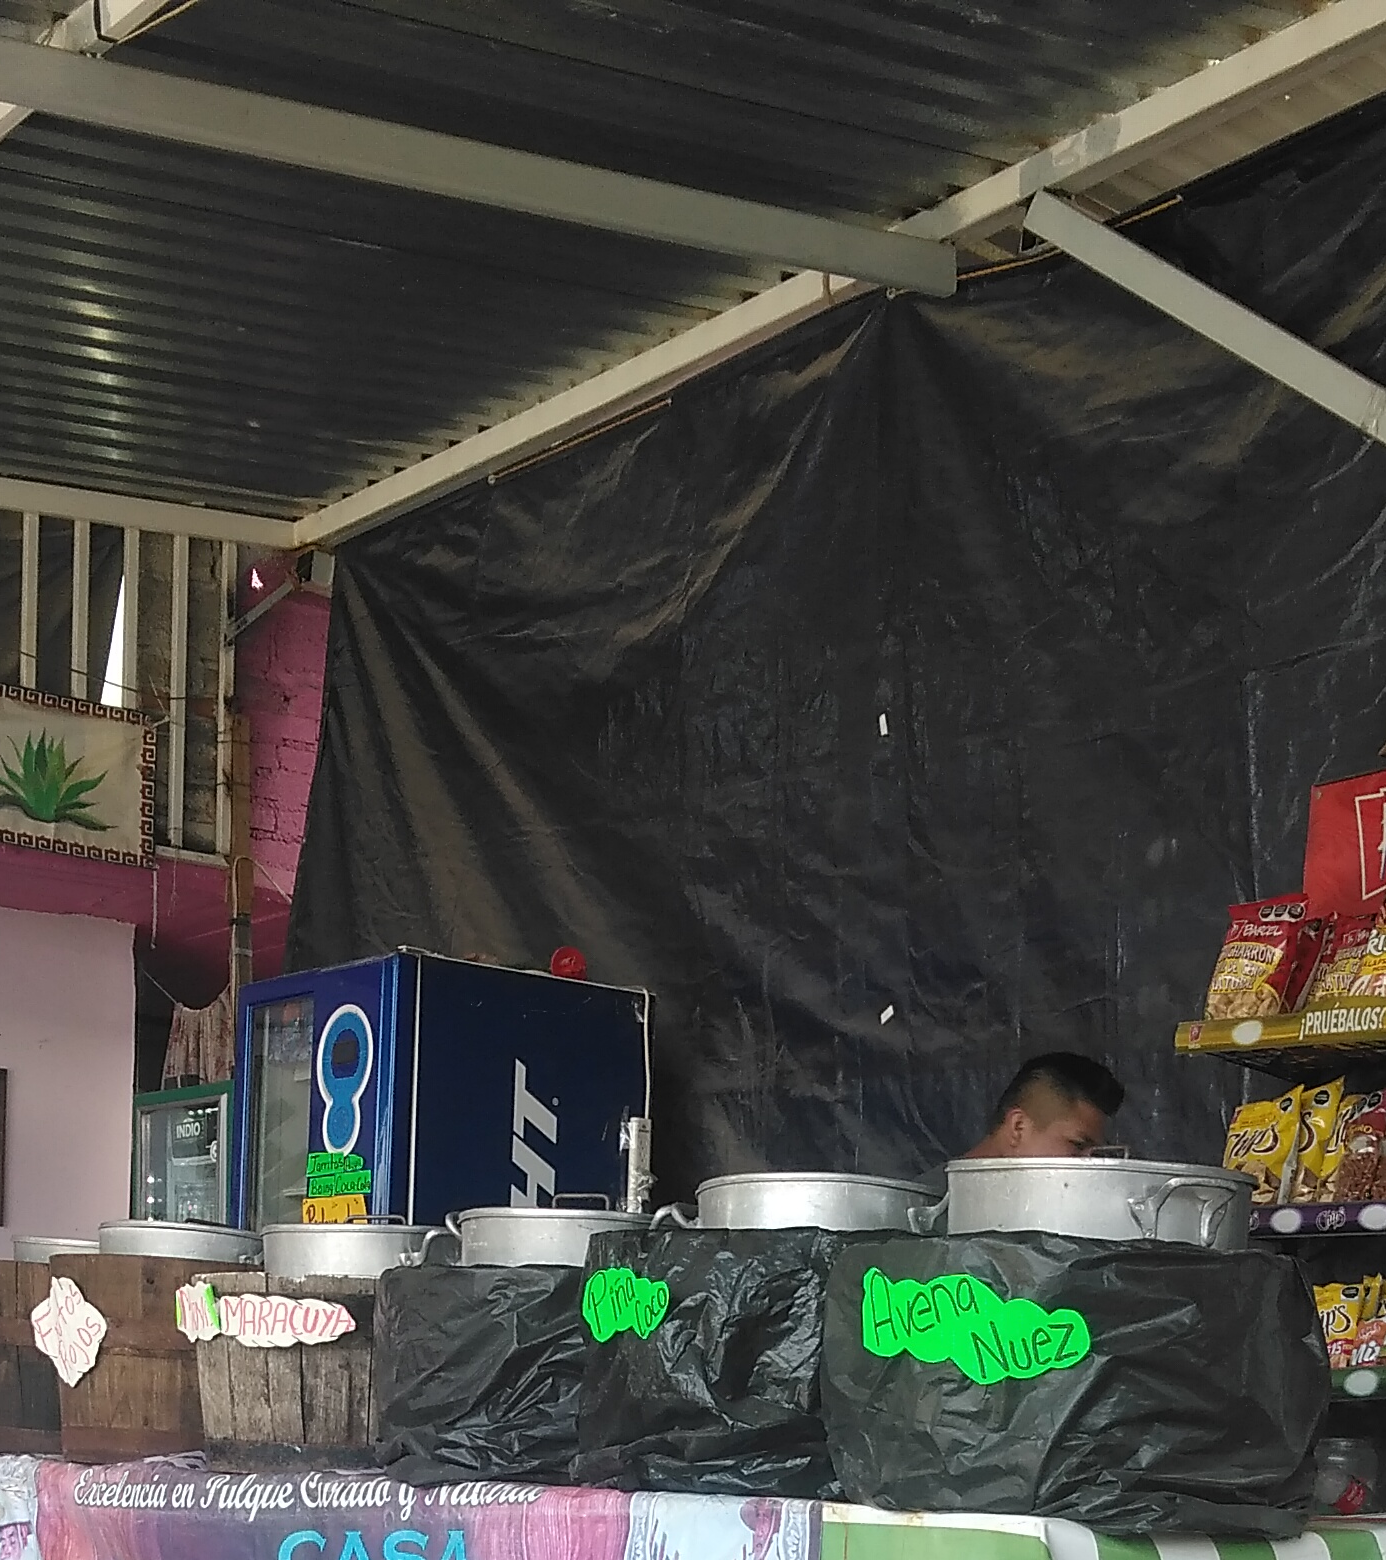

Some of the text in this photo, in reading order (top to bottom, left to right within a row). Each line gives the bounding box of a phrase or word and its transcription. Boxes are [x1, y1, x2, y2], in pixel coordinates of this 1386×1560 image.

[175, 1121, 201, 1139] INDIO
[870, 1271, 980, 1348] Avena
[971, 1321, 1079, 1380] Nuez
[73, 1469, 168, 1509] Excelencia
[171, 1482, 196, 1509] en
